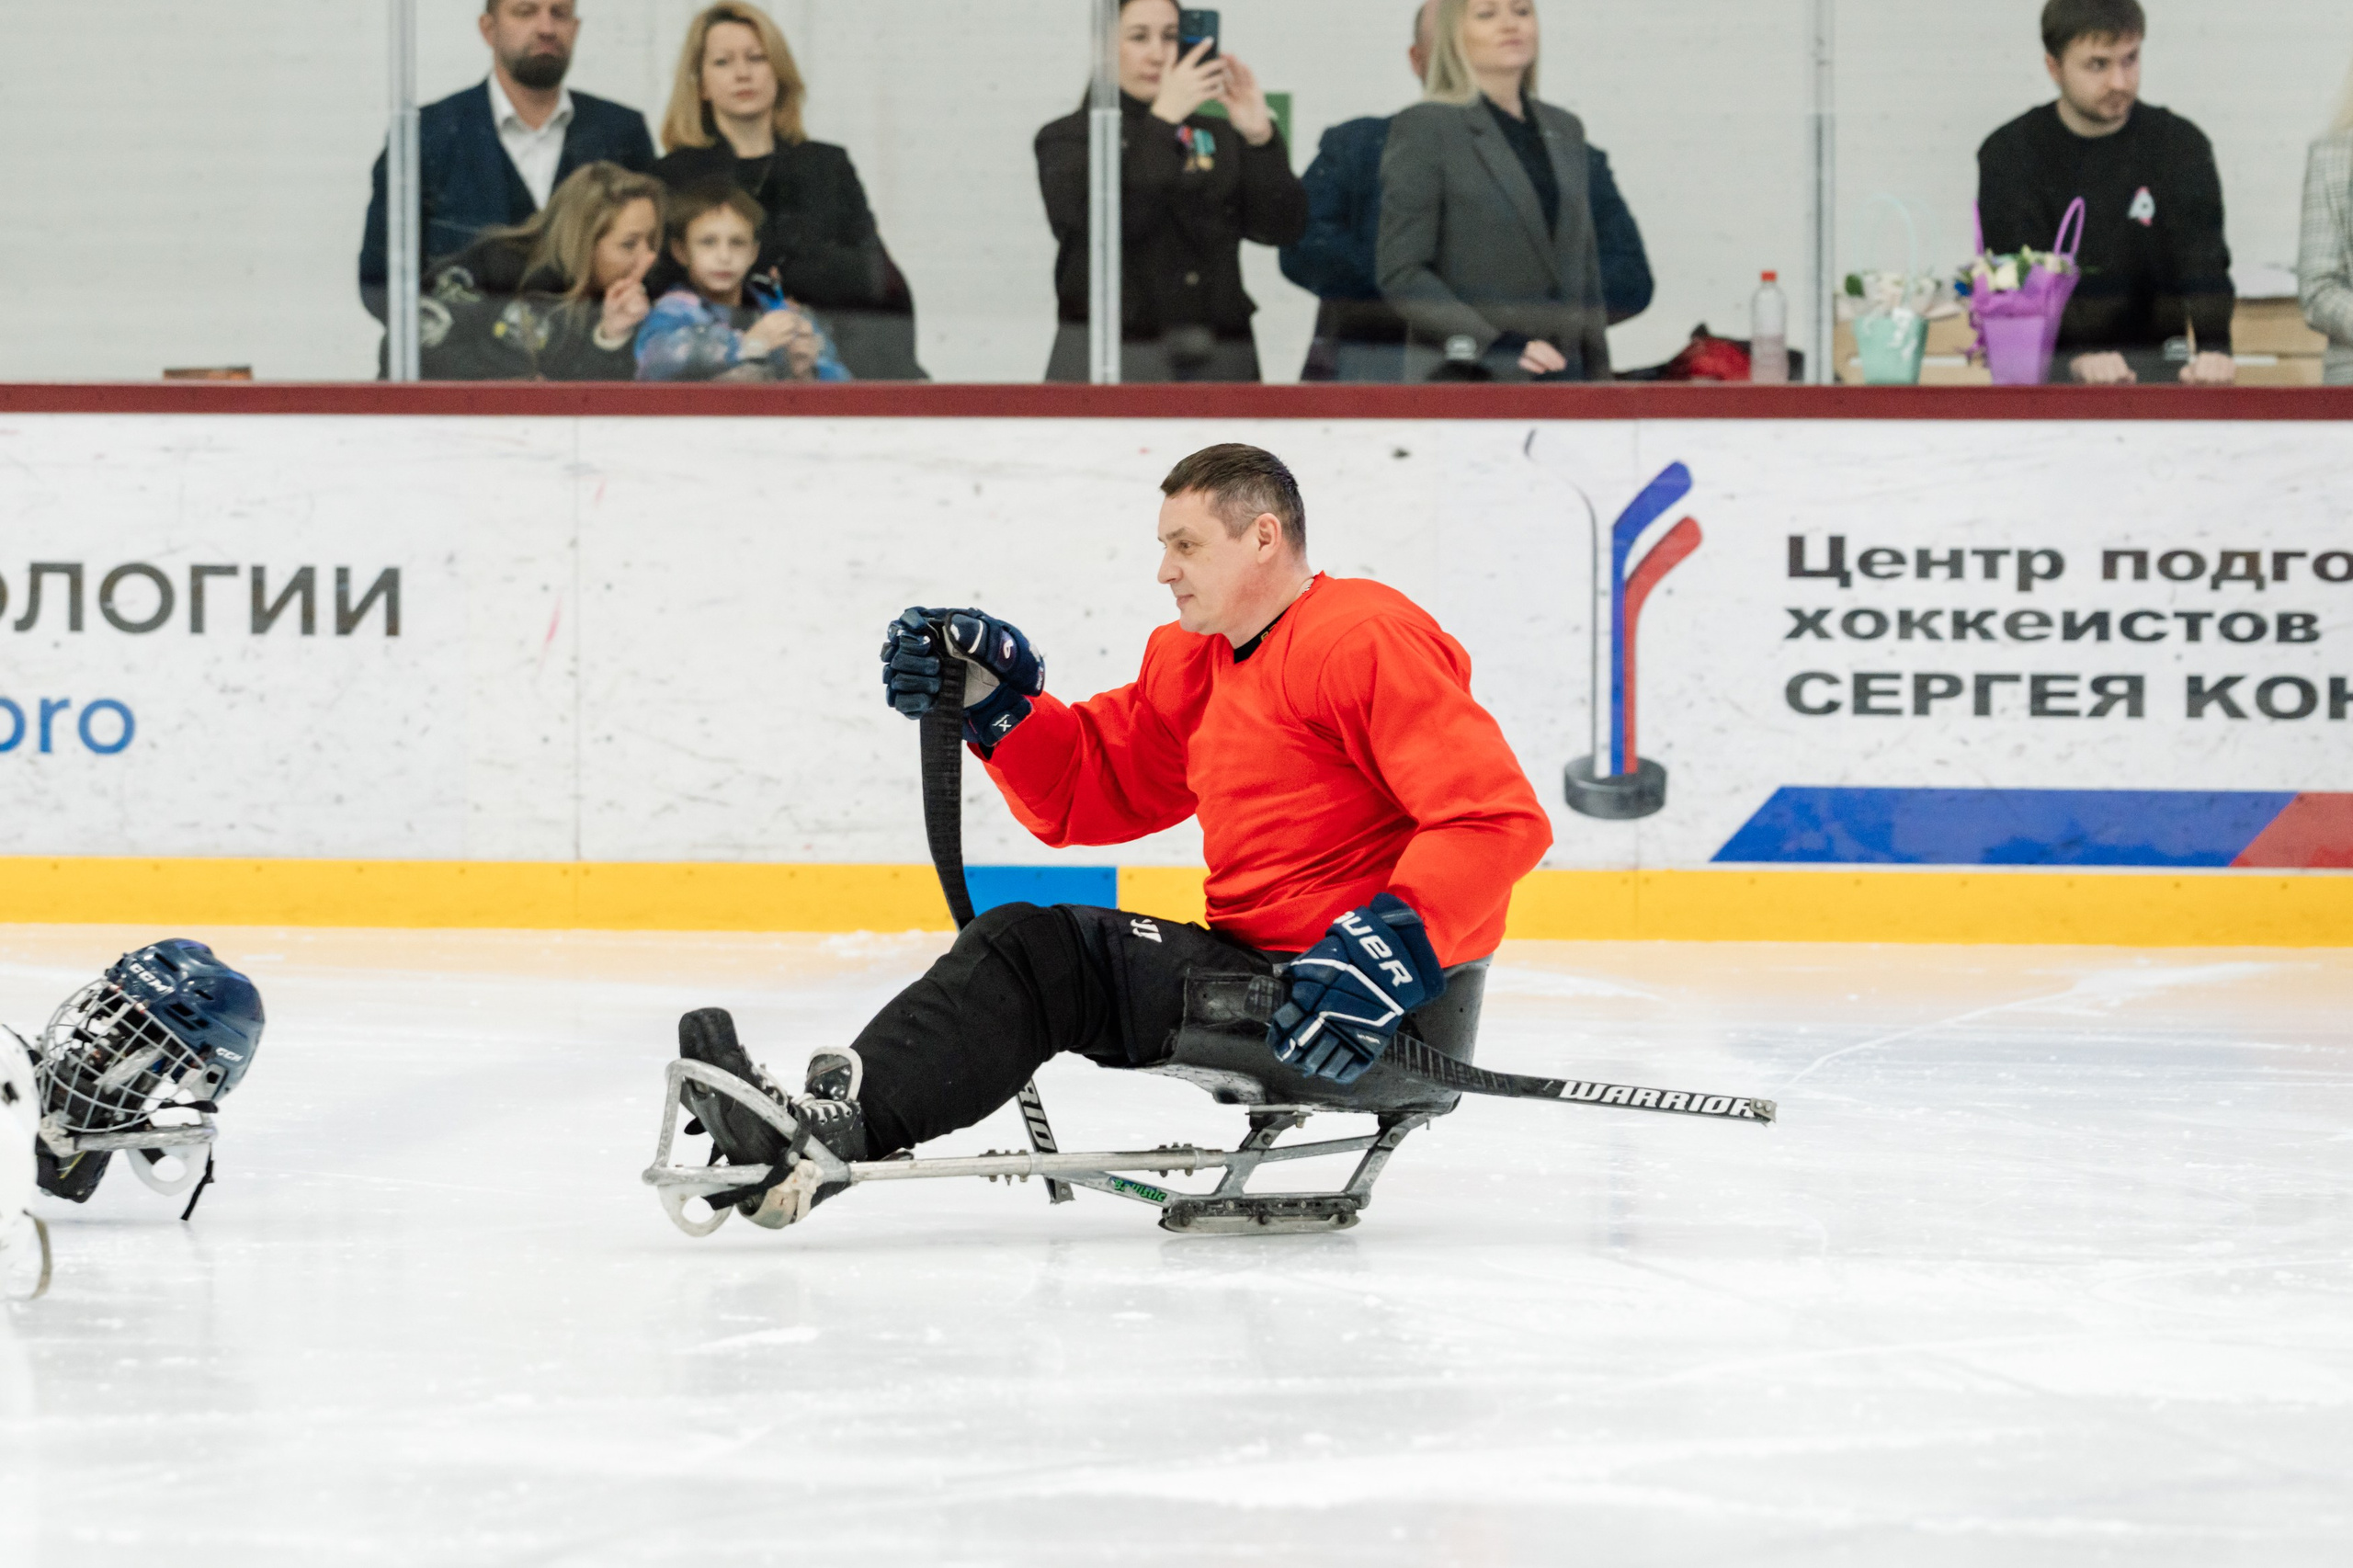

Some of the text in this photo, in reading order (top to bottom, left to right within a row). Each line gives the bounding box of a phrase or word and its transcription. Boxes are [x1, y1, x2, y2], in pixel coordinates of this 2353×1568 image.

[1788, 534, 2353, 593] Центр подго
[1785, 608, 2322, 644] хоккеистов
[1785, 671, 2145, 719] СЕРГЕЯ
[129, 962, 175, 994] CCM
[215, 1047, 244, 1062] CCM
